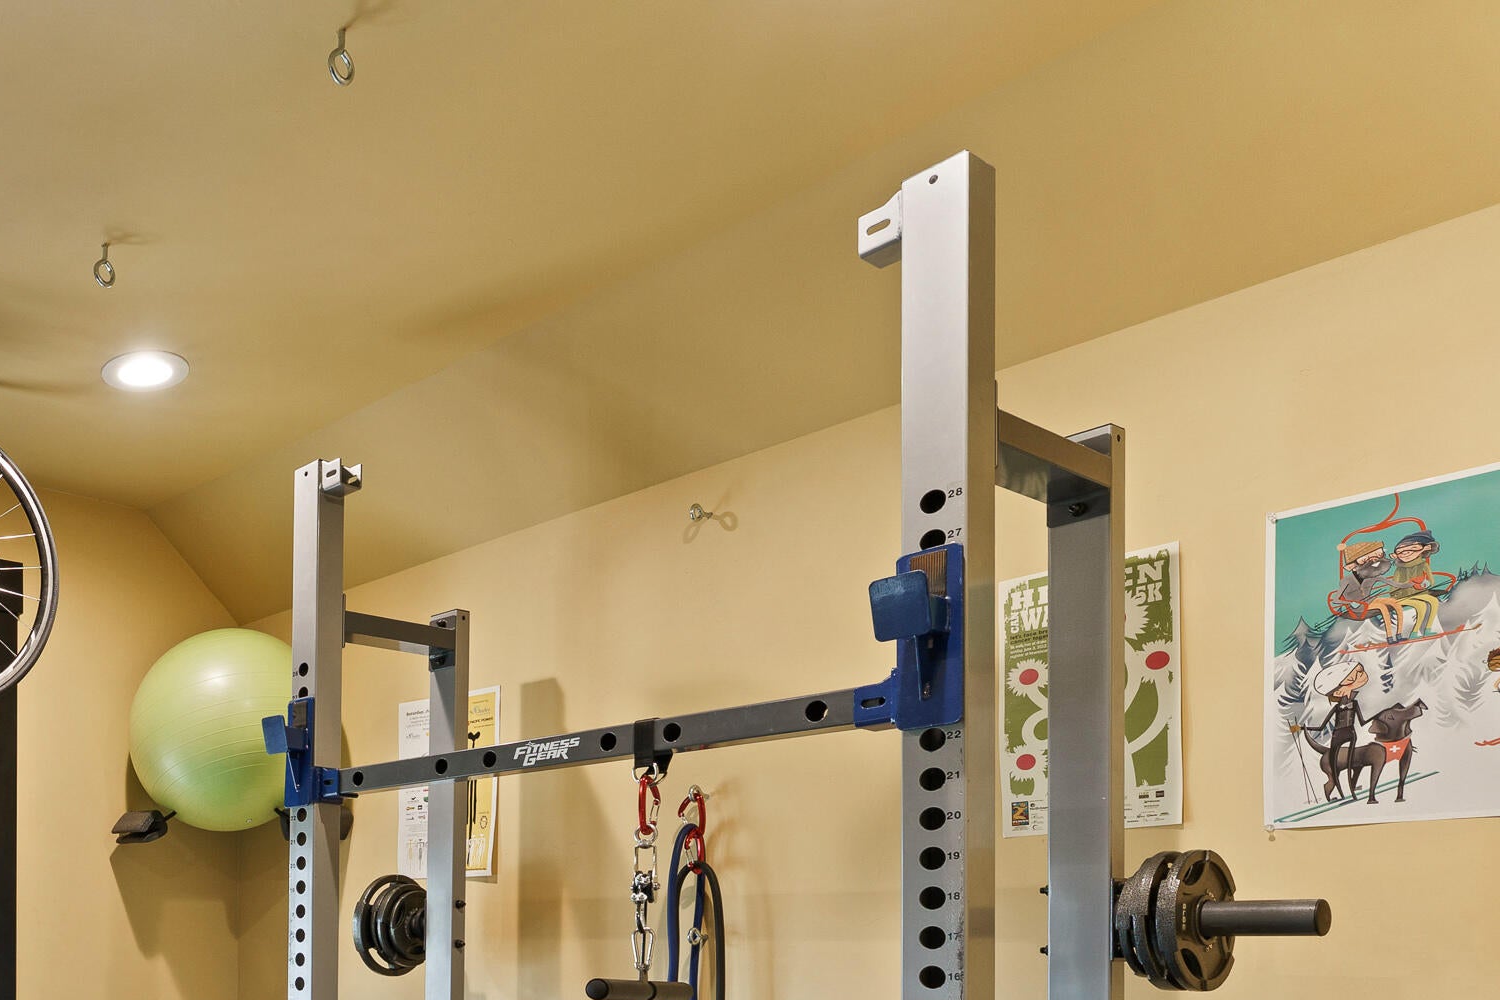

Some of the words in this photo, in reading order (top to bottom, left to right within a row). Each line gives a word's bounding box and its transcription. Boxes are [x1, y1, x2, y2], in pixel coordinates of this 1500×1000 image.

[947, 487, 963, 499] 28
[947, 527, 963, 539] 27
[946, 730, 962, 740] 22
[513, 737, 580, 760] FITNESS
[523, 747, 569, 767] GEAR
[946, 770, 960, 780] 21
[946, 810, 962, 820] 20
[947, 851, 960, 861] 19
[947, 892, 960, 901] 18
[947, 932, 960, 941] 17
[947, 972, 961, 981] 16
